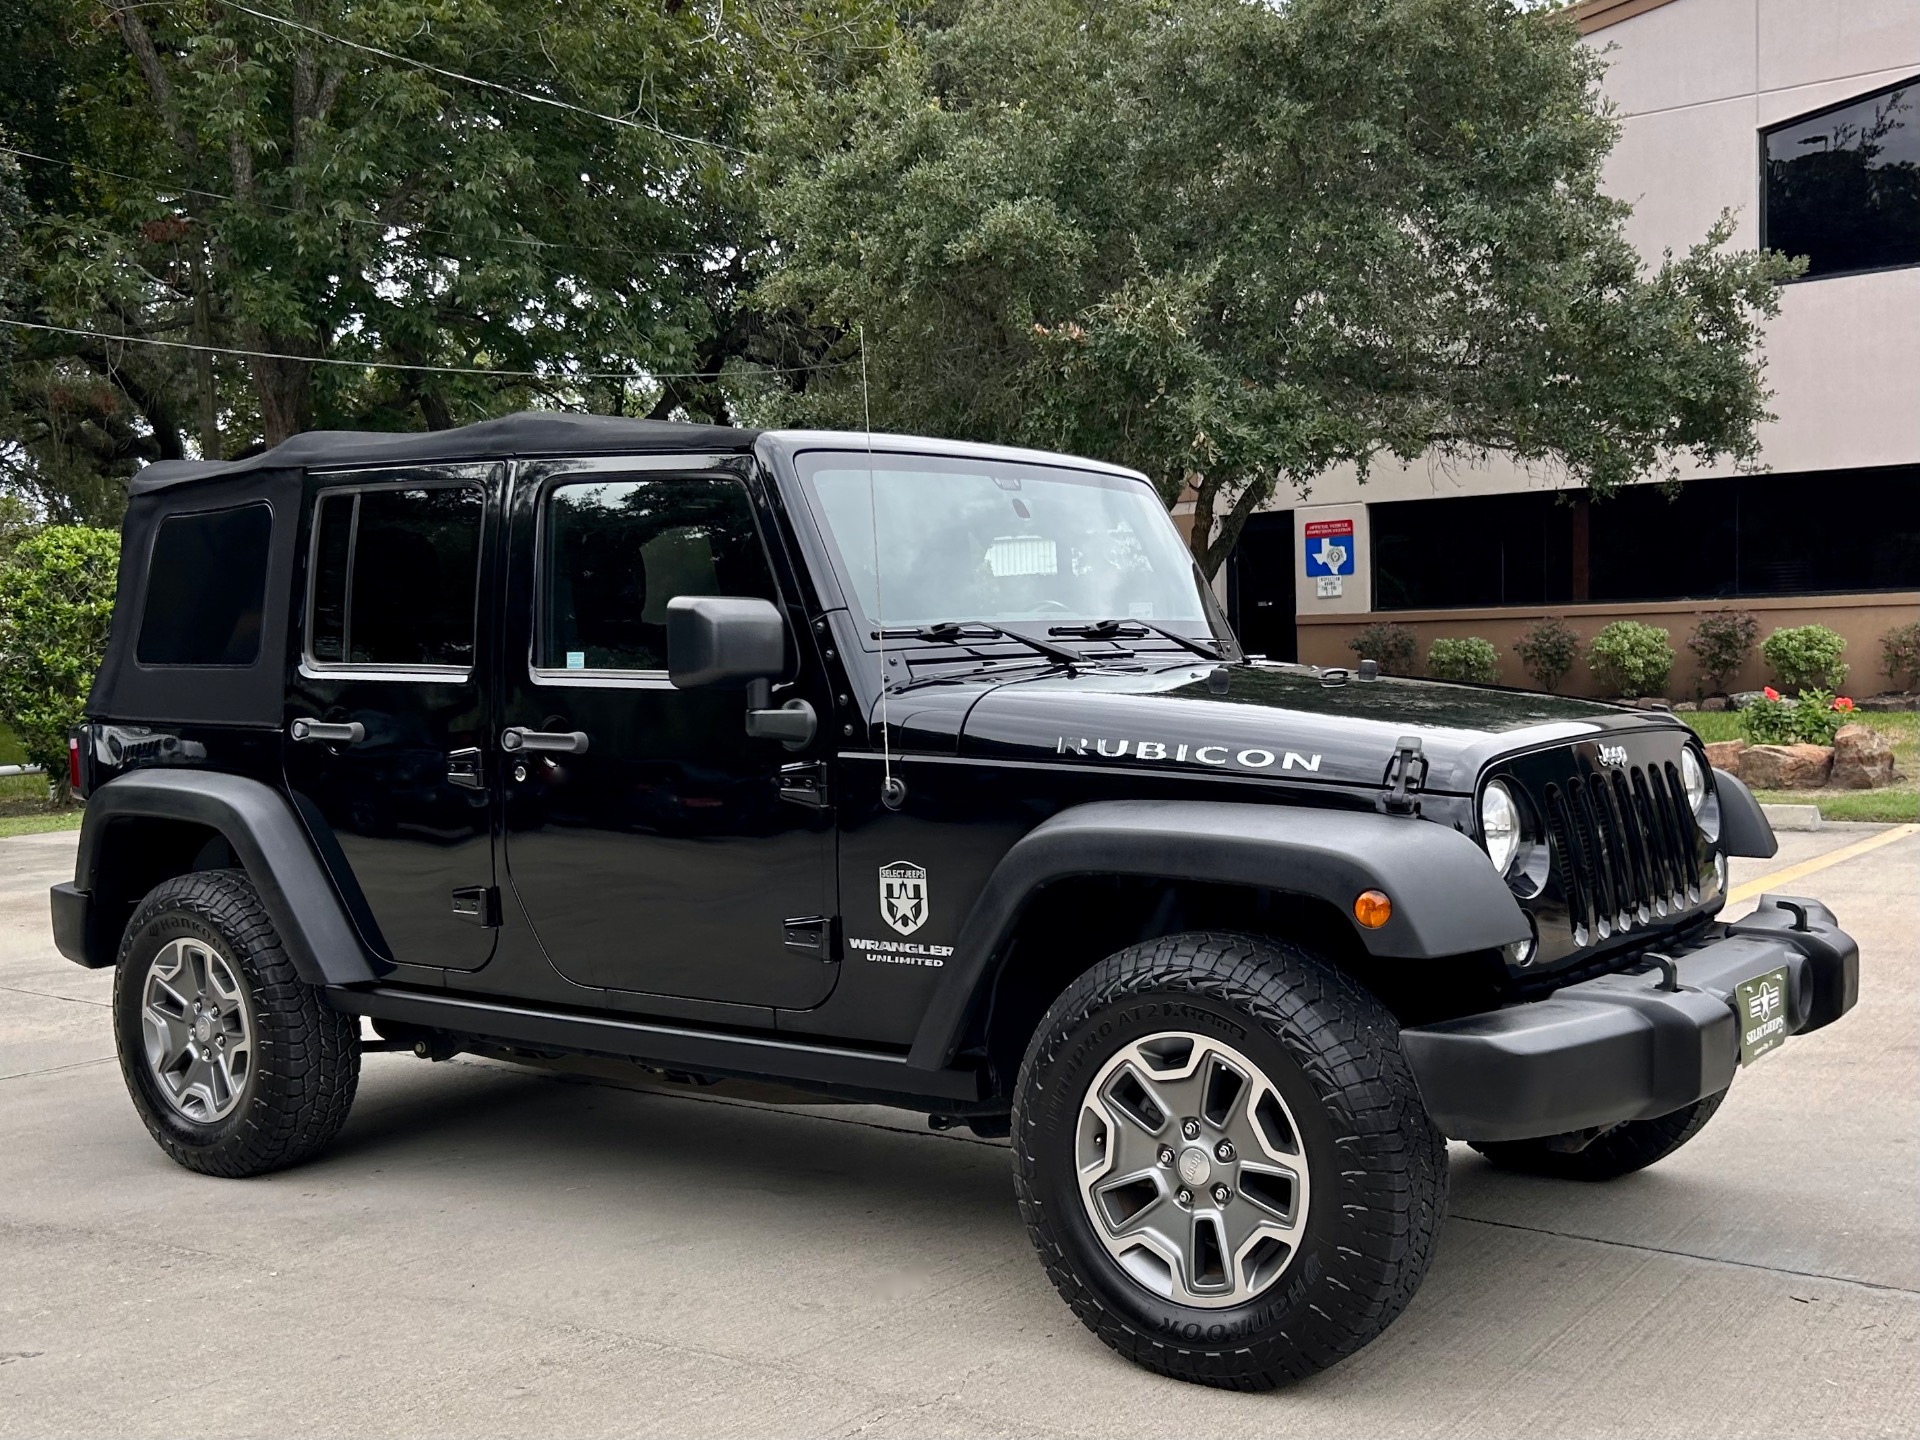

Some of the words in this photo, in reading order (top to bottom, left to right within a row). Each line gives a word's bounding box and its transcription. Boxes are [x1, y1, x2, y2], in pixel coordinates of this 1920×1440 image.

[1056, 736, 1322, 772] RUBICON
[1595, 743, 1628, 767] Jeep
[848, 938, 954, 956] WRANGLER
[866, 954, 944, 967] UNLIMITED
[1118, 1003, 1160, 1028] AT2
